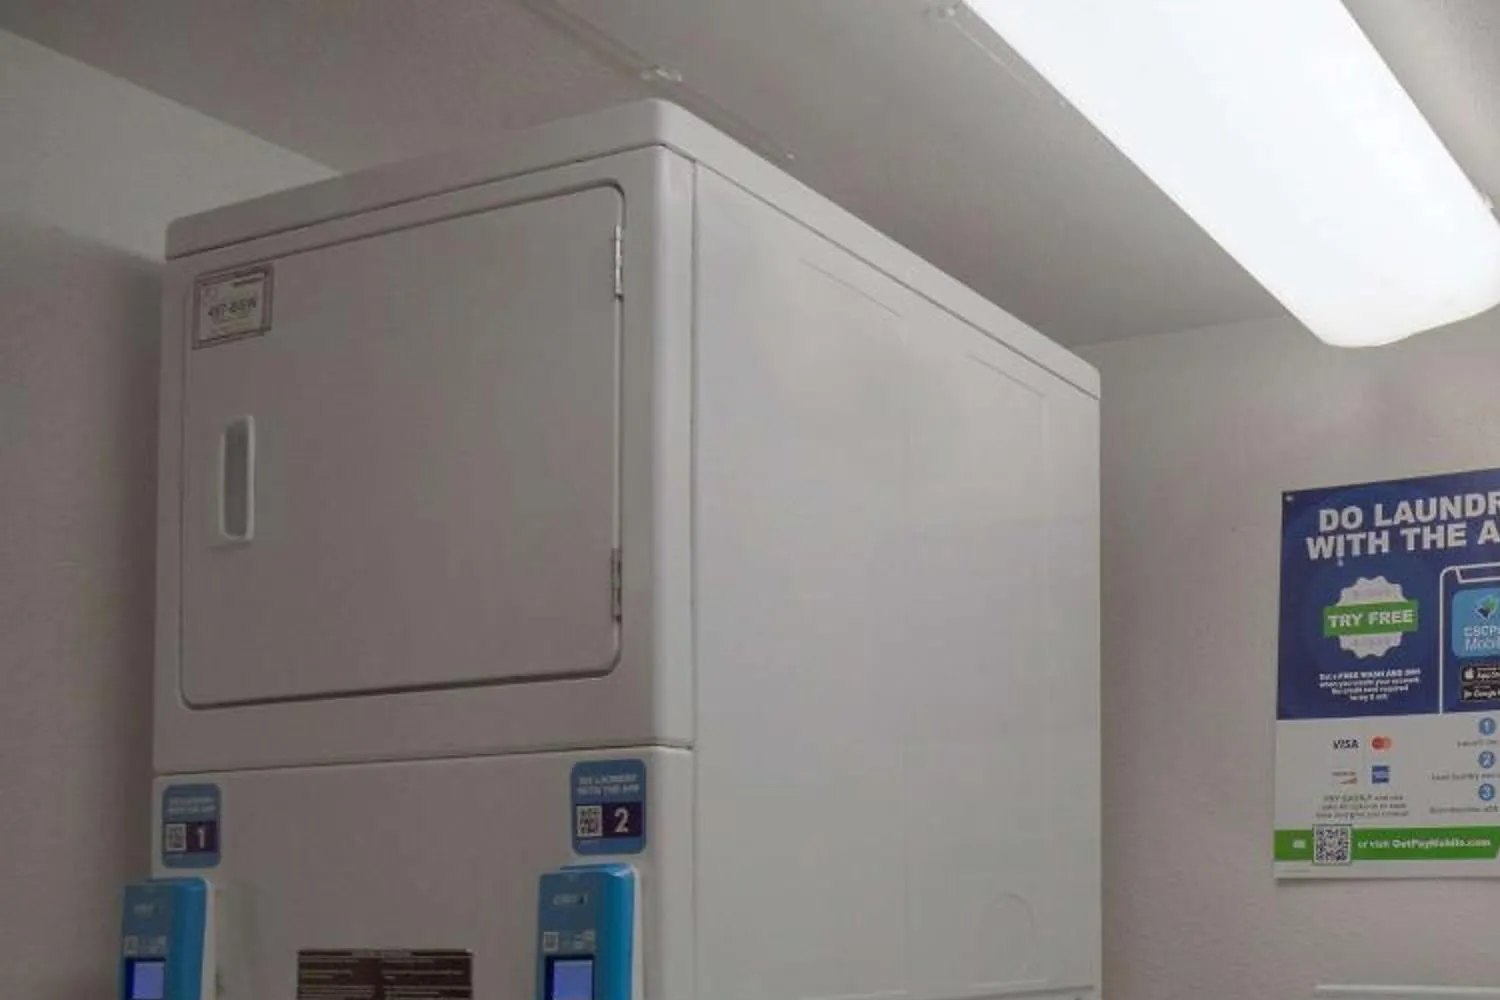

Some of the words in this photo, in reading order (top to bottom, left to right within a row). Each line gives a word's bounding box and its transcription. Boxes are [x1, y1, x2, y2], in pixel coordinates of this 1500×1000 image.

[1319, 506, 1363, 532] DO
[1306, 530, 1390, 560] WITH
[1400, 520, 1467, 551] THE
[1328, 613, 1364, 628] TRY
[1368, 608, 1415, 626] FREE
[1332, 737, 1360, 750] VISA
[614, 806, 630, 833] 2
[197, 827, 206, 850] 1
